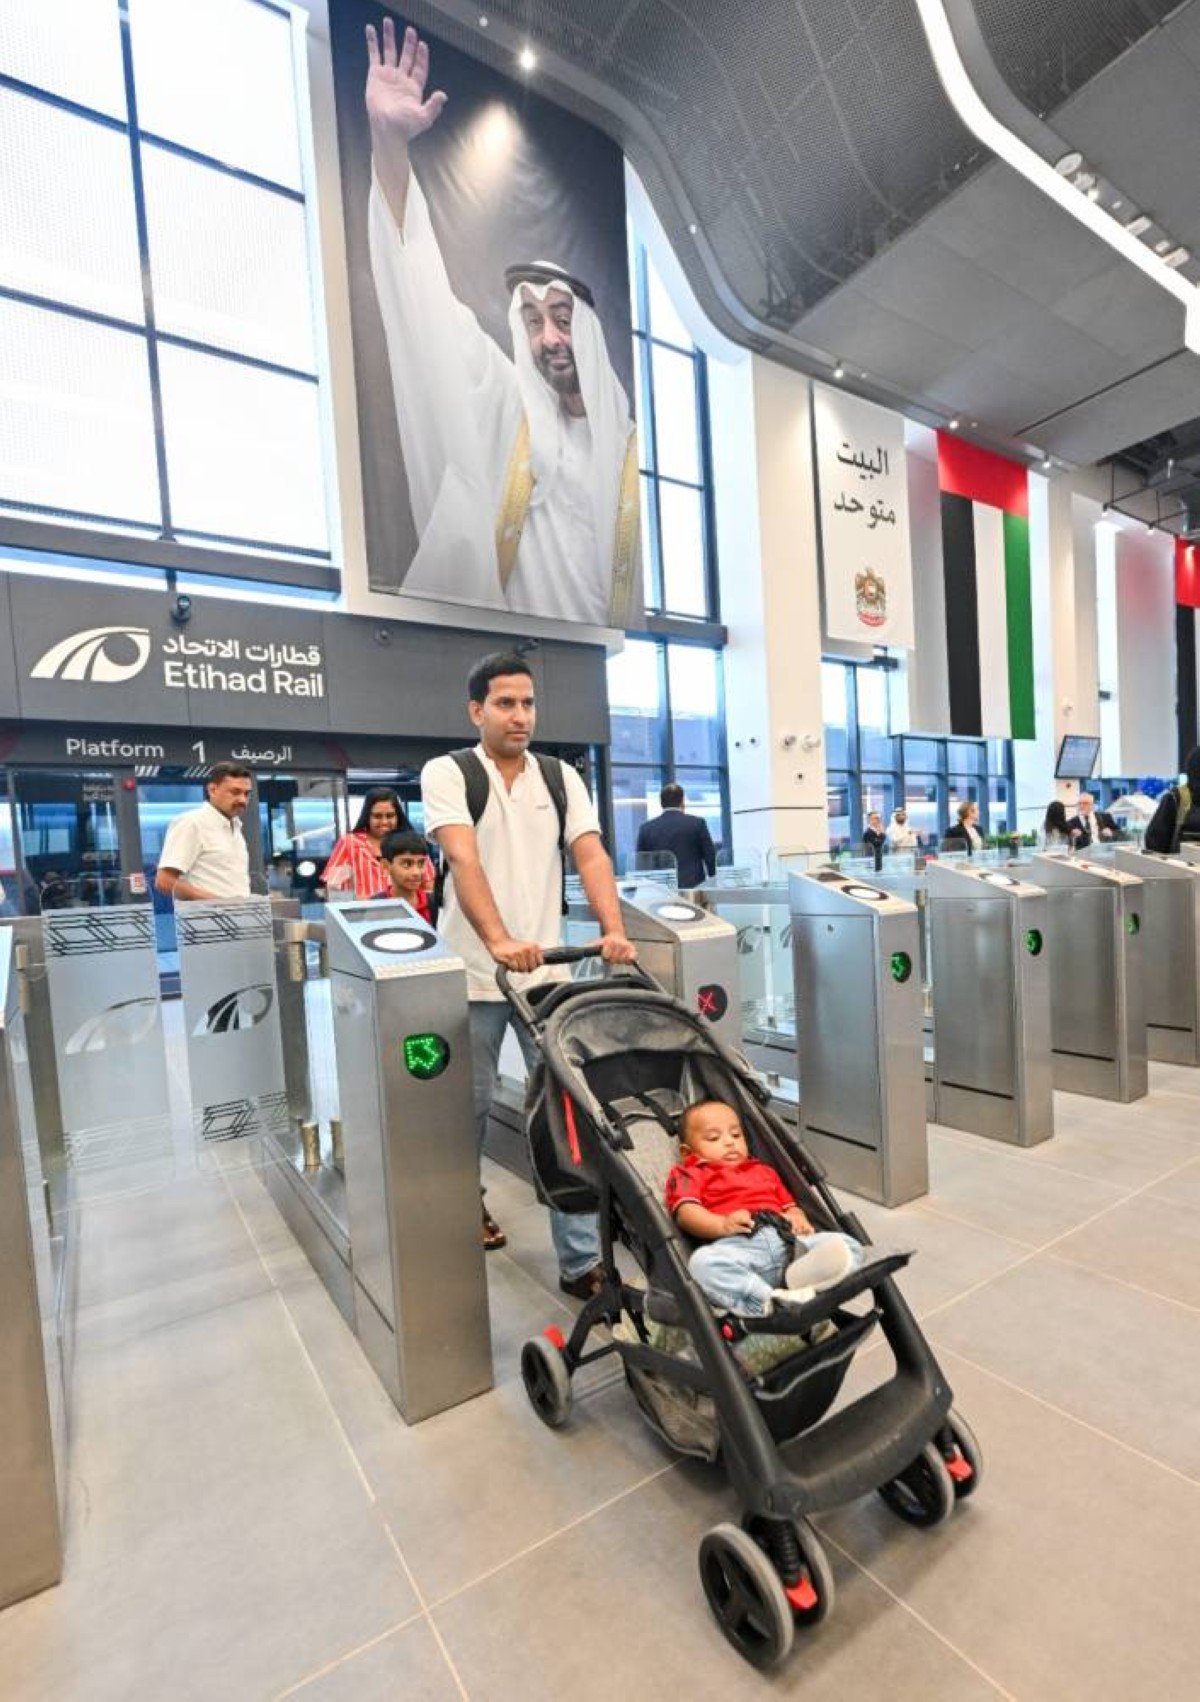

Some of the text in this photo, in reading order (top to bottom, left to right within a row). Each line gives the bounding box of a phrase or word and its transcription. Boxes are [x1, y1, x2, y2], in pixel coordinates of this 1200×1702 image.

[836, 442, 889, 480] البيت
[834, 491, 896, 529] متوحد
[162, 634, 321, 668] قطارات الاتحاد
[163, 660, 323, 697] Etihad Rail
[66, 738, 205, 763] Platform 1
[231, 744, 293, 764] الرصيف
